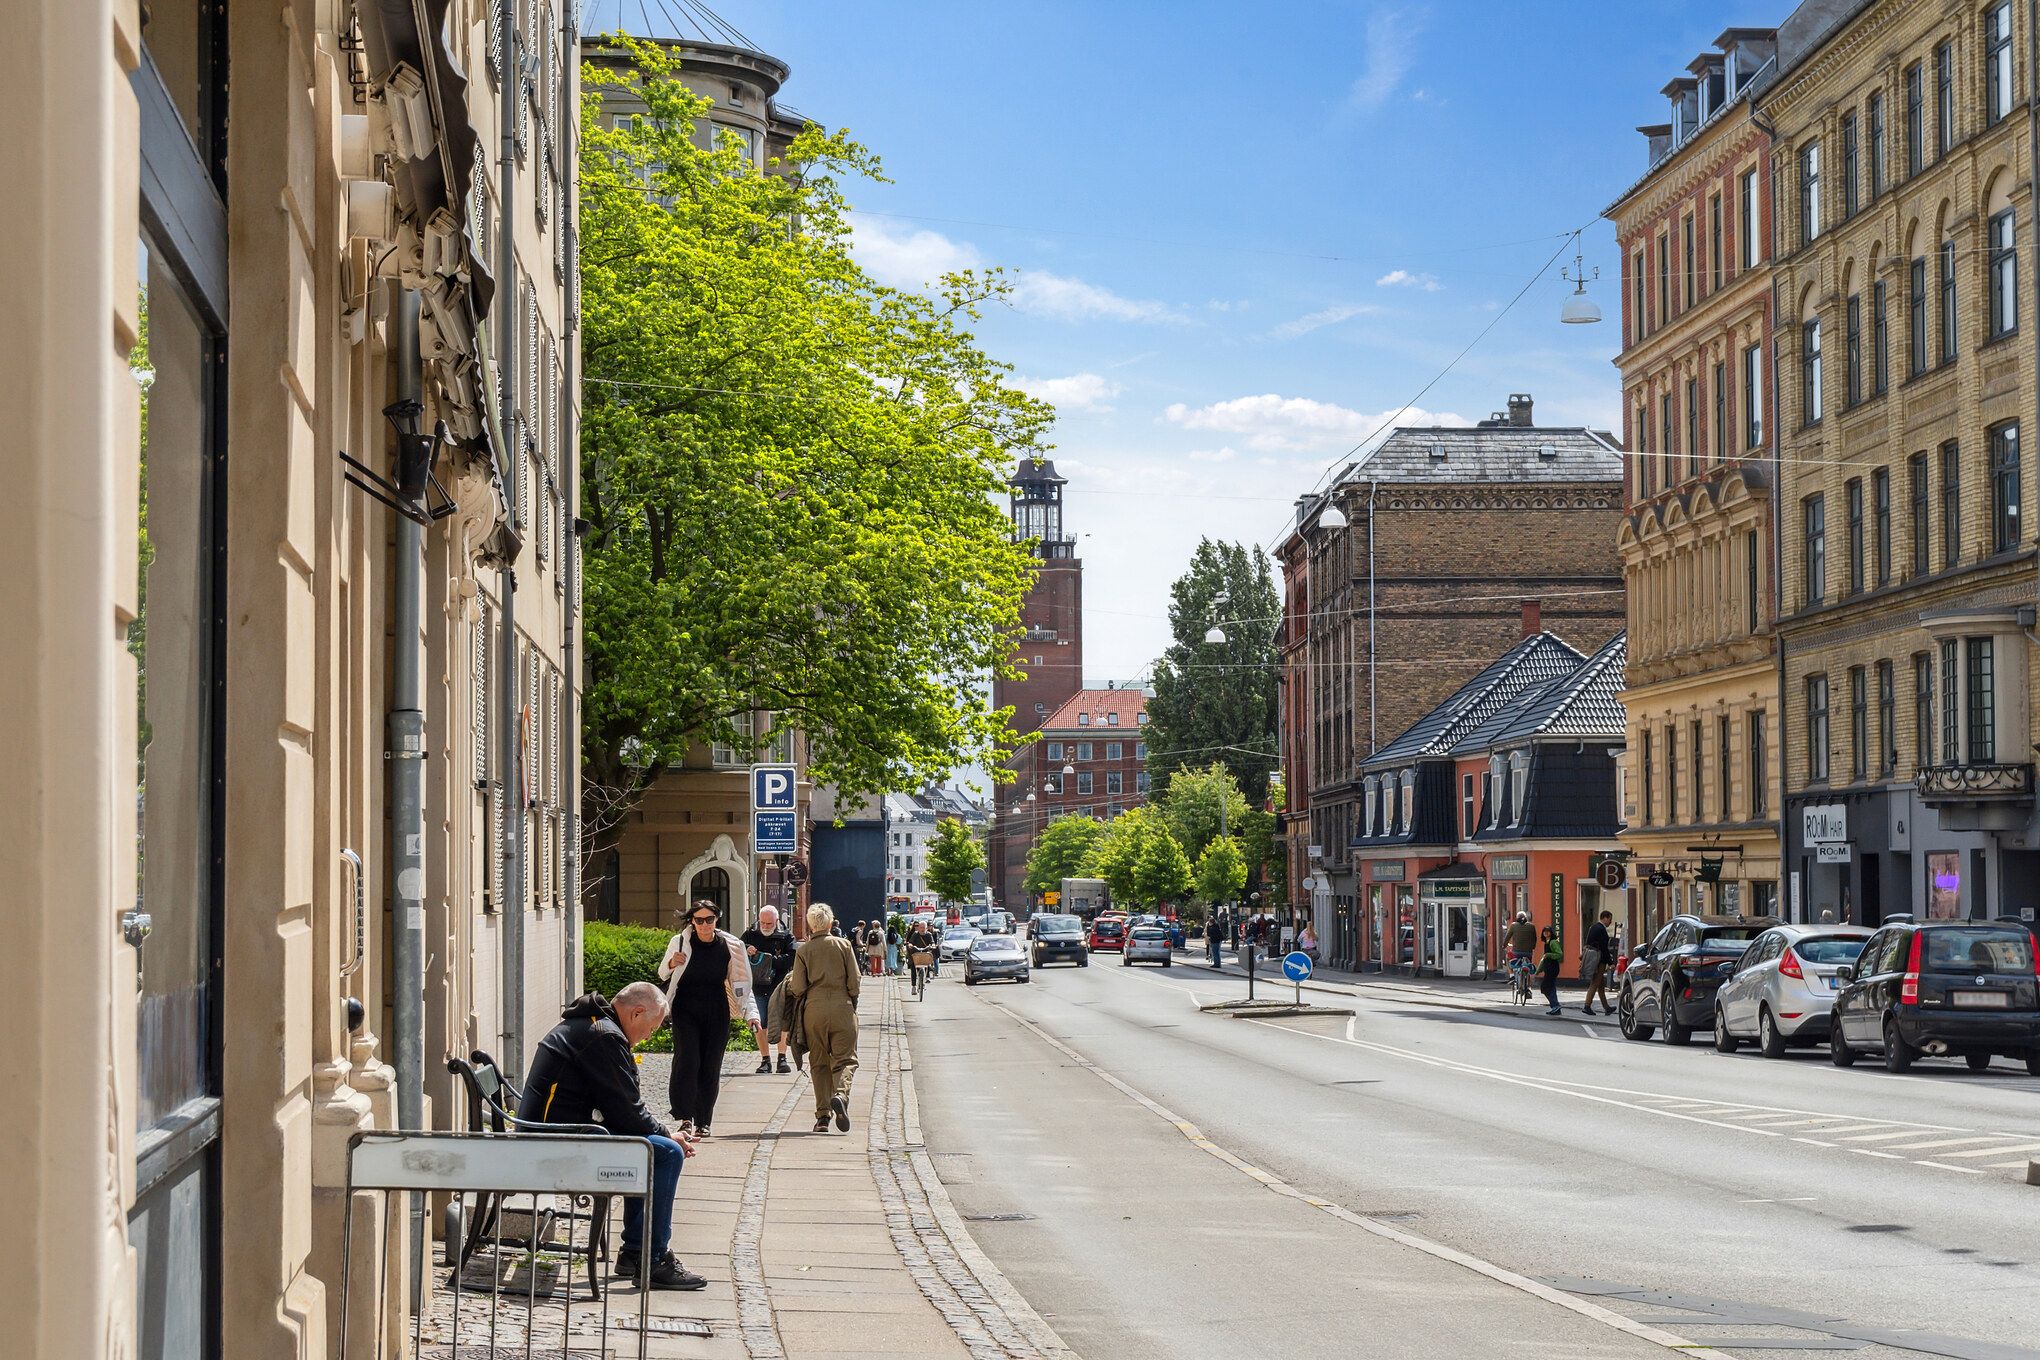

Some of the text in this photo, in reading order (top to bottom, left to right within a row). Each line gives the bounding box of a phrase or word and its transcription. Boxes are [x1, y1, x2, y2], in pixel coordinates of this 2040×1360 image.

[765, 773, 788, 804] P
[1829, 821, 1843, 837] HAIR
[1604, 864, 1619, 886] B
